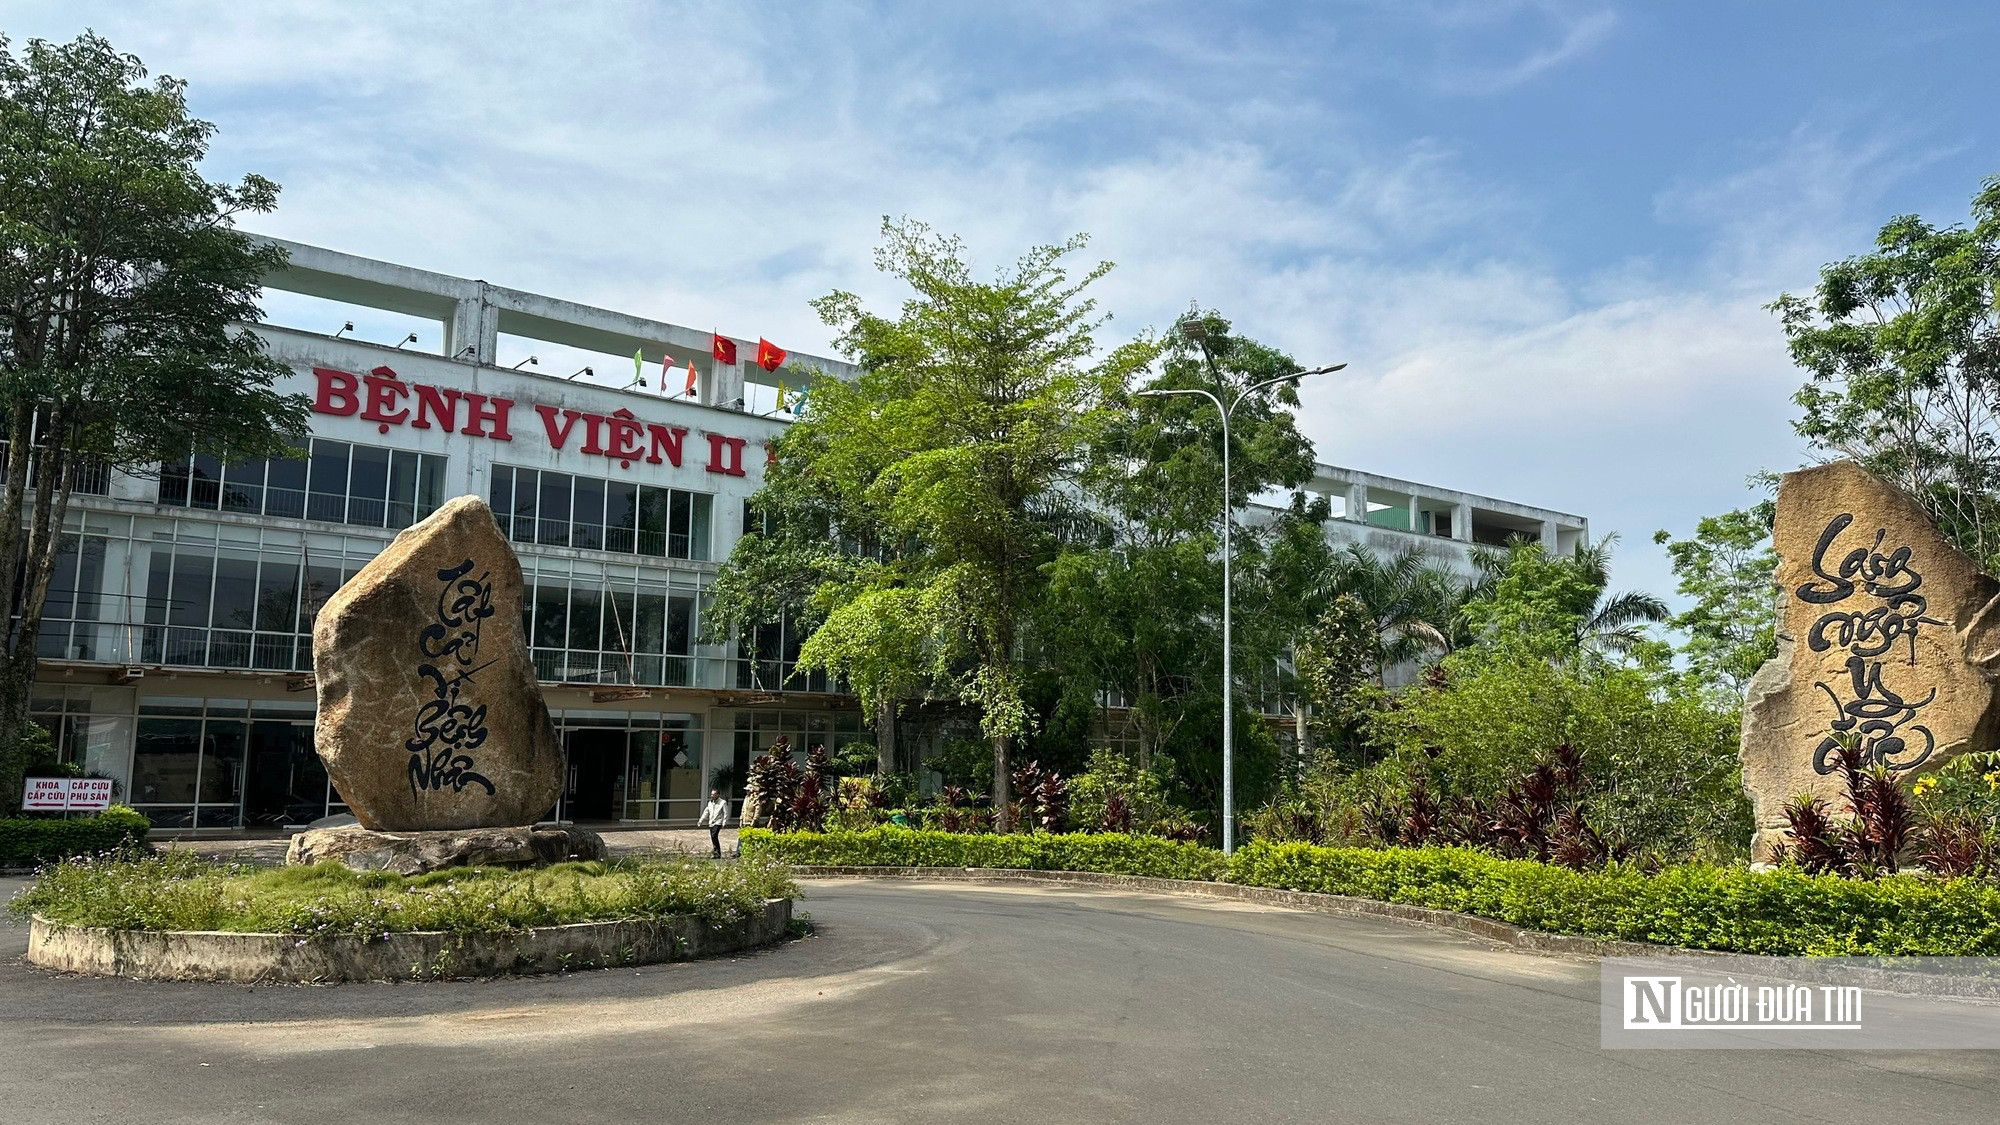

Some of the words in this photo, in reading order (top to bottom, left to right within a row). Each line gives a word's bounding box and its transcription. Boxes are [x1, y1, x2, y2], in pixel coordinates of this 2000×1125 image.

[312, 366, 515, 441] BỆNH
[535, 408, 688, 469] VIỆN
[705, 433, 746, 477] II
[36, 781, 59, 789] KHOA
[72, 779, 89, 790] CẤP
[92, 780, 109, 790] CỨU
[27, 789, 45, 800] CẤP
[48, 790, 65, 800] CỨU
[70, 792, 88, 802] PHỤ
[90, 790, 108, 801] SẢN
